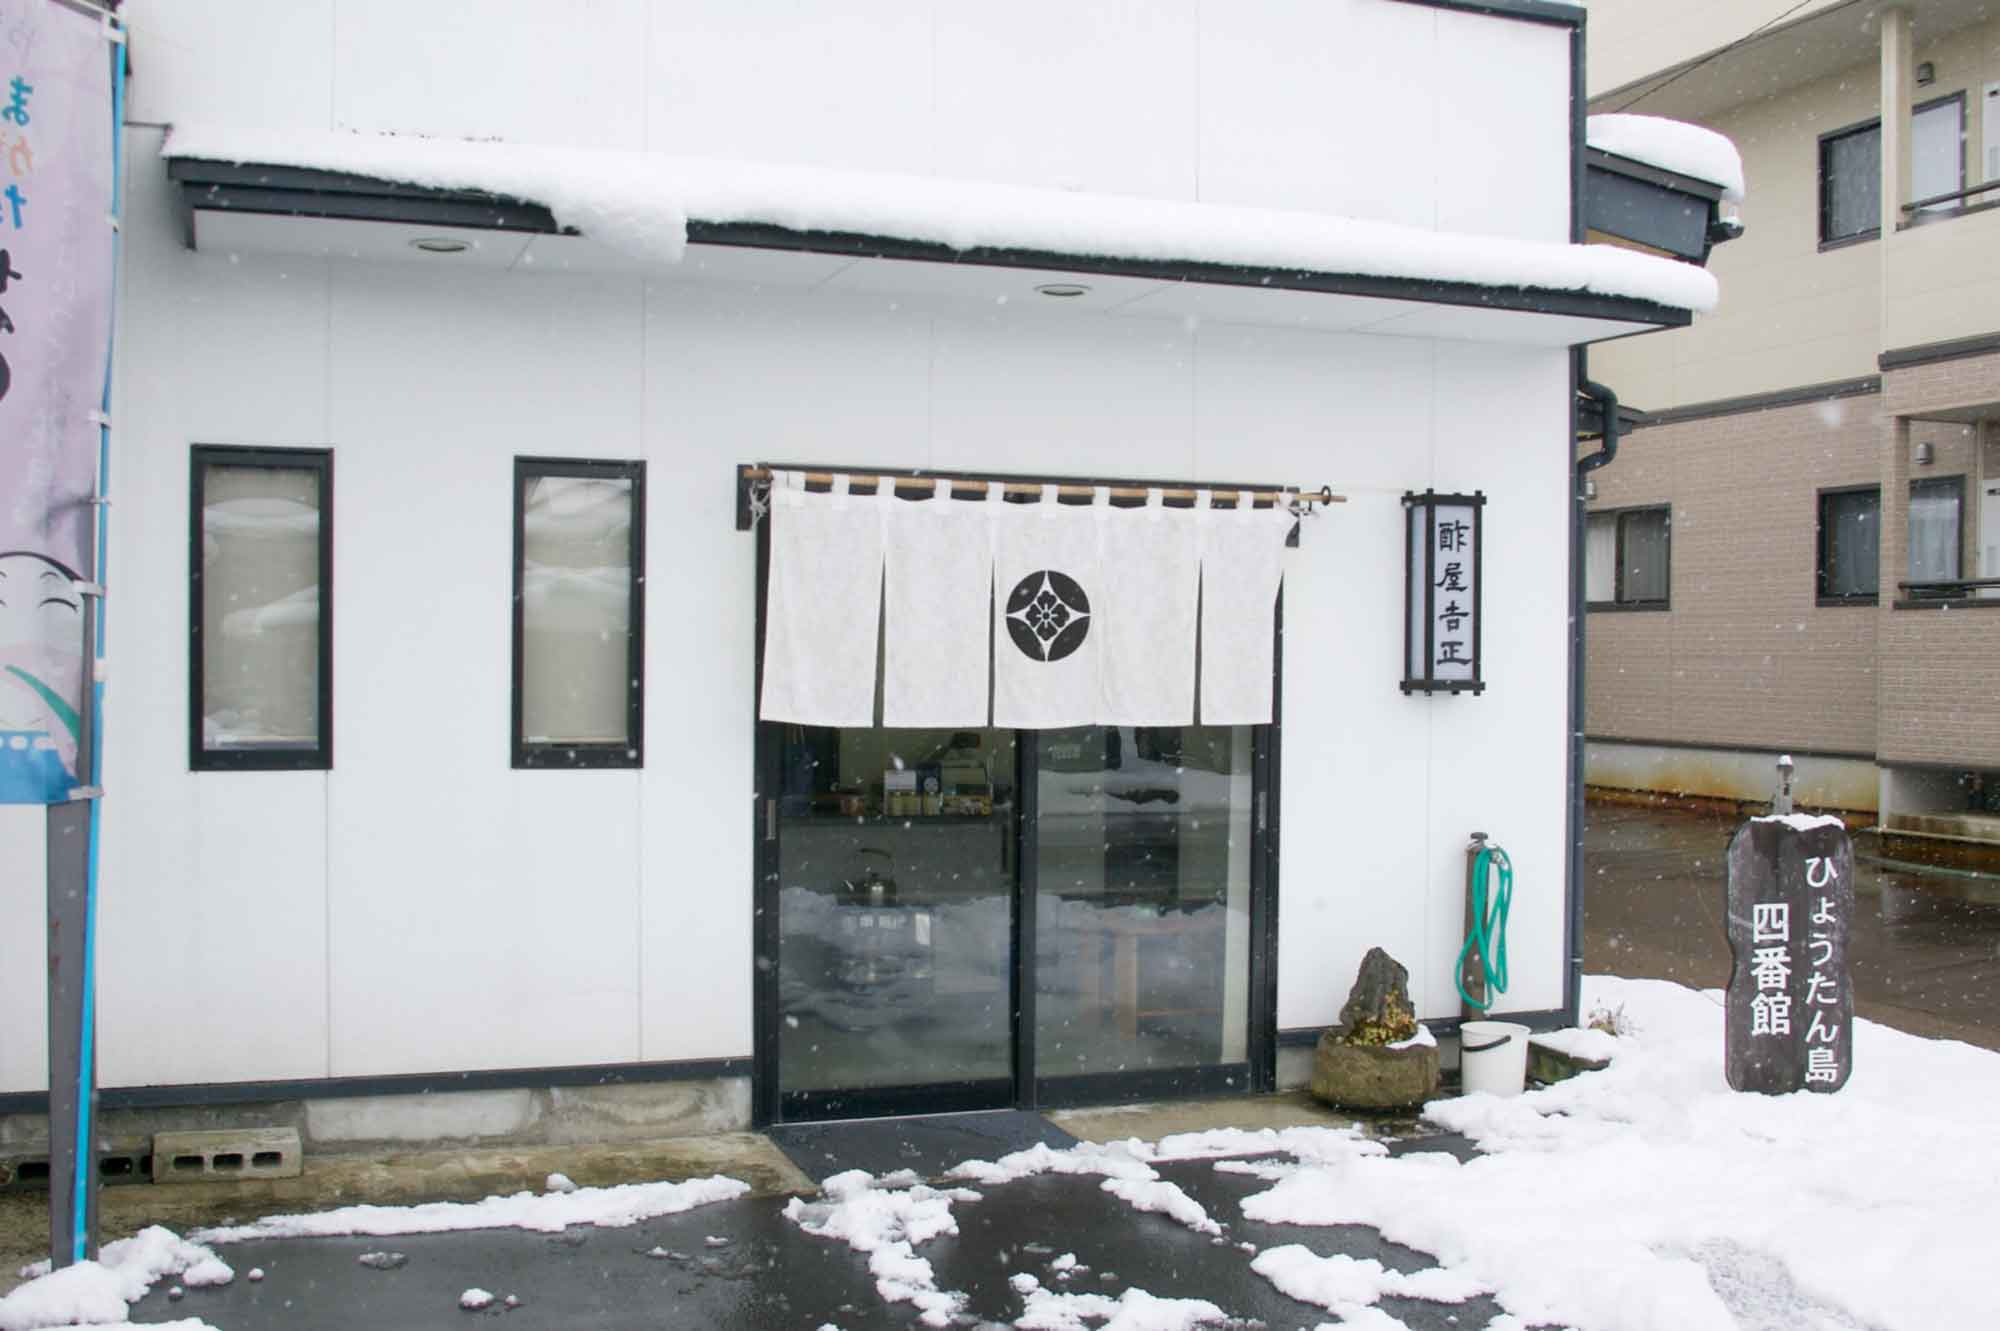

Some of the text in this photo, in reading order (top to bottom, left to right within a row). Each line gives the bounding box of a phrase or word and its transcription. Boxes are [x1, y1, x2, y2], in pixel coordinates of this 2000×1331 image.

[1435, 519, 1473, 666] 酢屋吉正
[1750, 902, 1792, 1037] 四番館
[1805, 856, 1839, 1083] ひょうたん島
